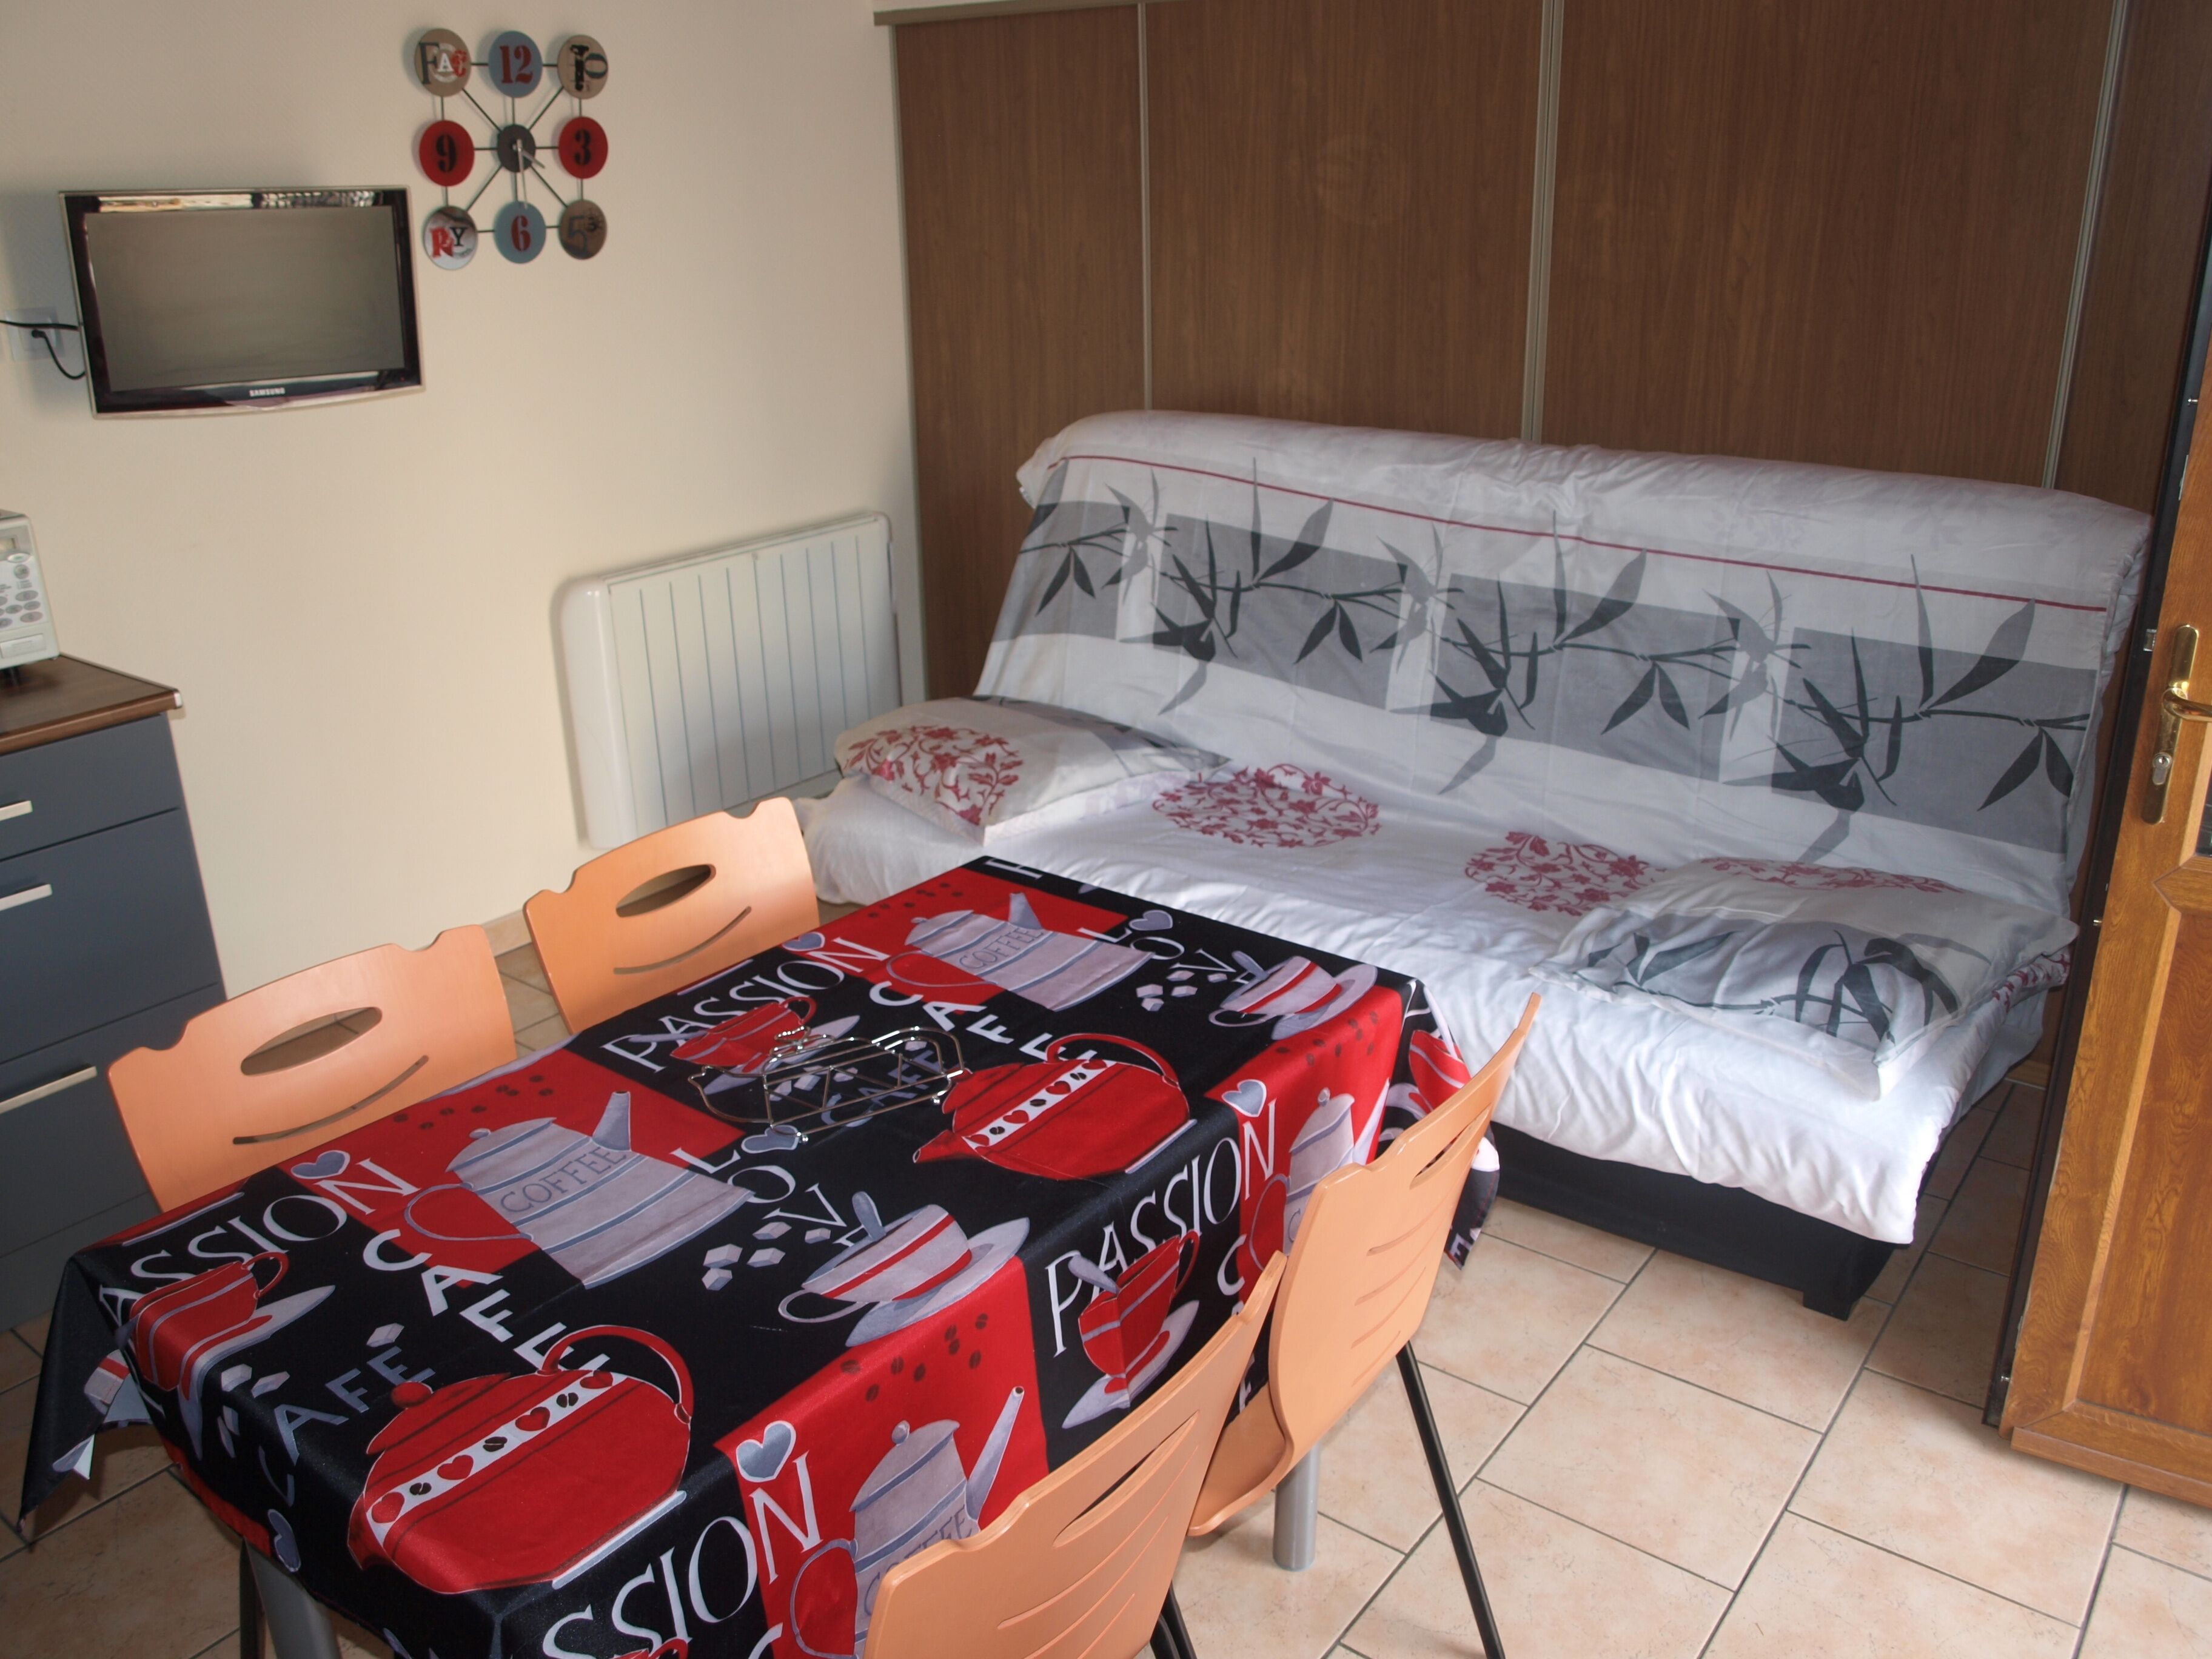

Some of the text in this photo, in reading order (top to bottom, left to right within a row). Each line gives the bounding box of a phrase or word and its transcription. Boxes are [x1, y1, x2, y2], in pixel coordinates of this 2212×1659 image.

[499, 44, 534, 84] 12
[436, 133, 457, 173] 9
[574, 128, 592, 166] 3
[511, 215, 532, 252] 6
[249, 387, 286, 397] SAMSUNG
[959, 927, 1044, 970] COFFEE
[600, 936, 890, 1073] PASSION
[869, 980, 1098, 1062] CAFE
[500, 1146, 627, 1213] COFFEE
[1045, 1099, 1278, 1358] PASSION
[363, 1228, 611, 1372] CAFE
[258, 1346, 436, 1508] CAFE
